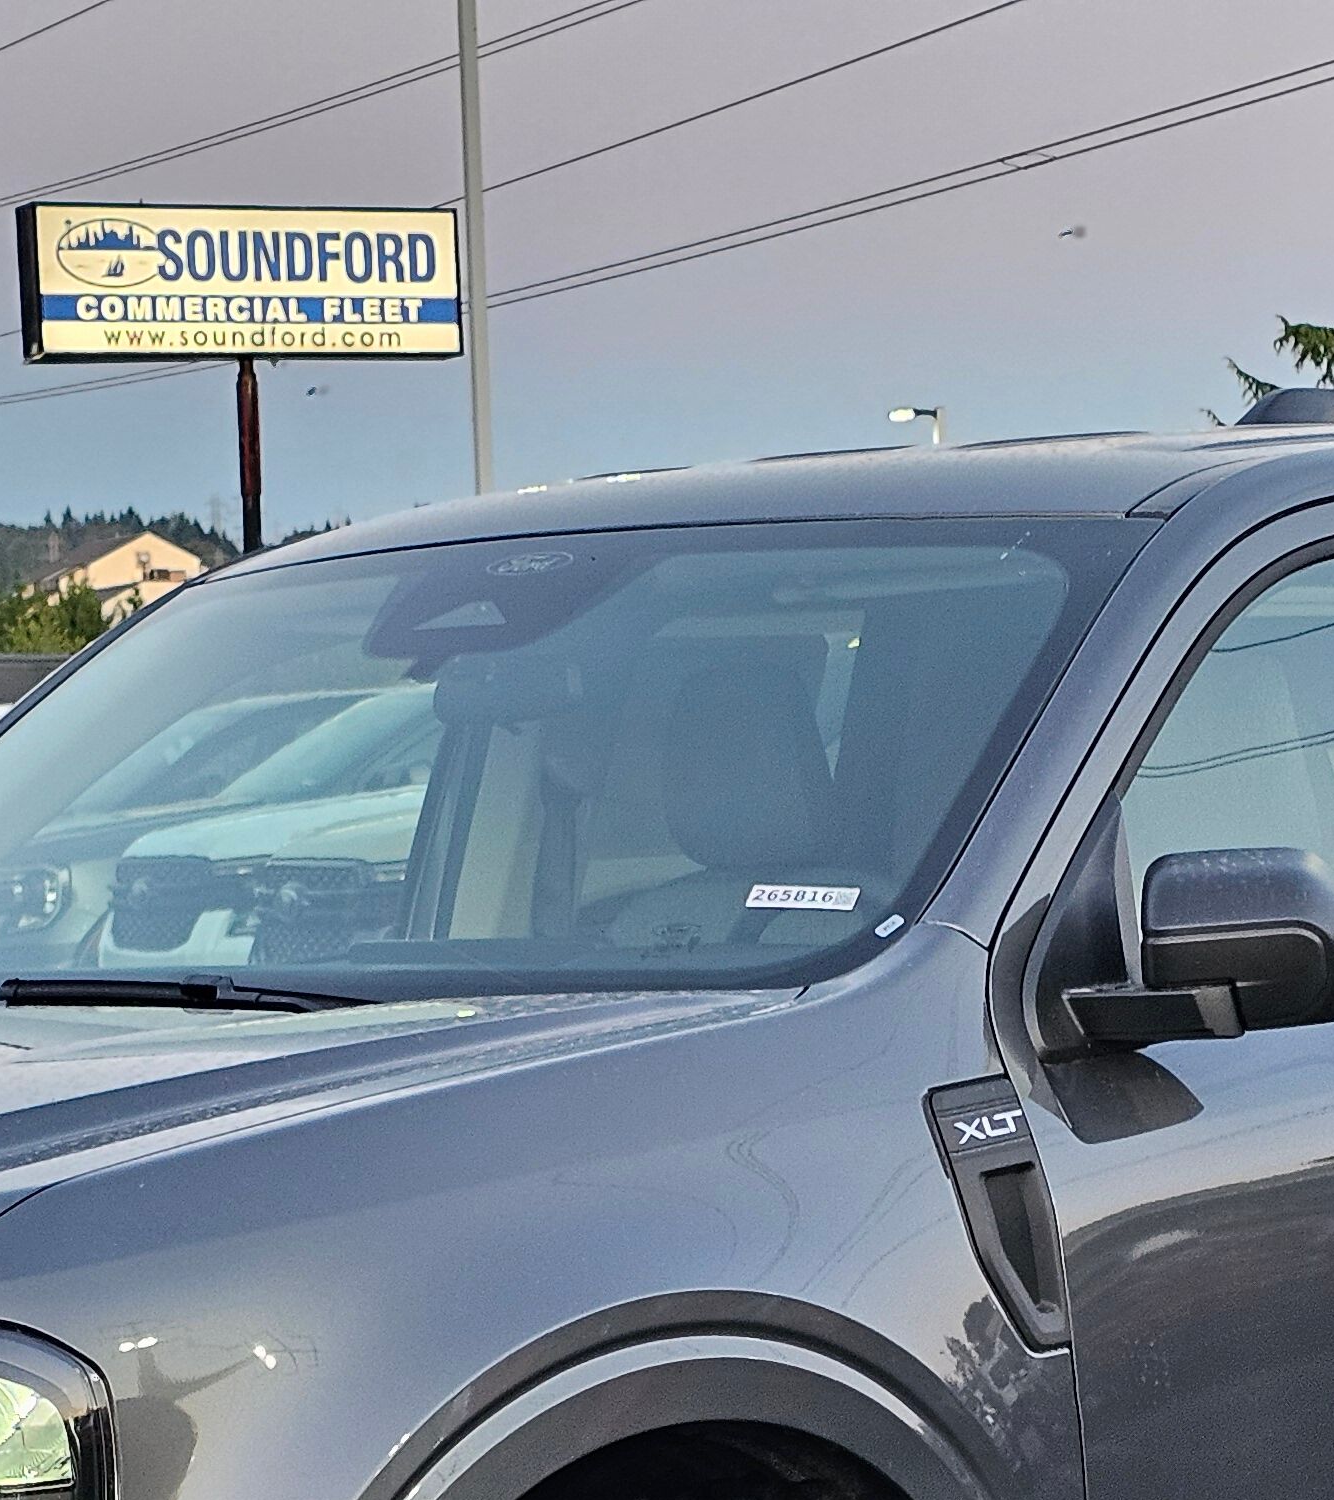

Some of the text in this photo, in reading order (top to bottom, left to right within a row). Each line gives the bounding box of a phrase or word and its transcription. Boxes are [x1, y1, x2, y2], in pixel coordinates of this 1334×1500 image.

[158, 229, 436, 283] SOUNDFORD
[76, 295, 423, 323] COMMERCIAL FLEET
[103, 326, 402, 348] www.soundford.com
[752, 888, 835, 903] 265816
[953, 1109, 1023, 1145] XLT
